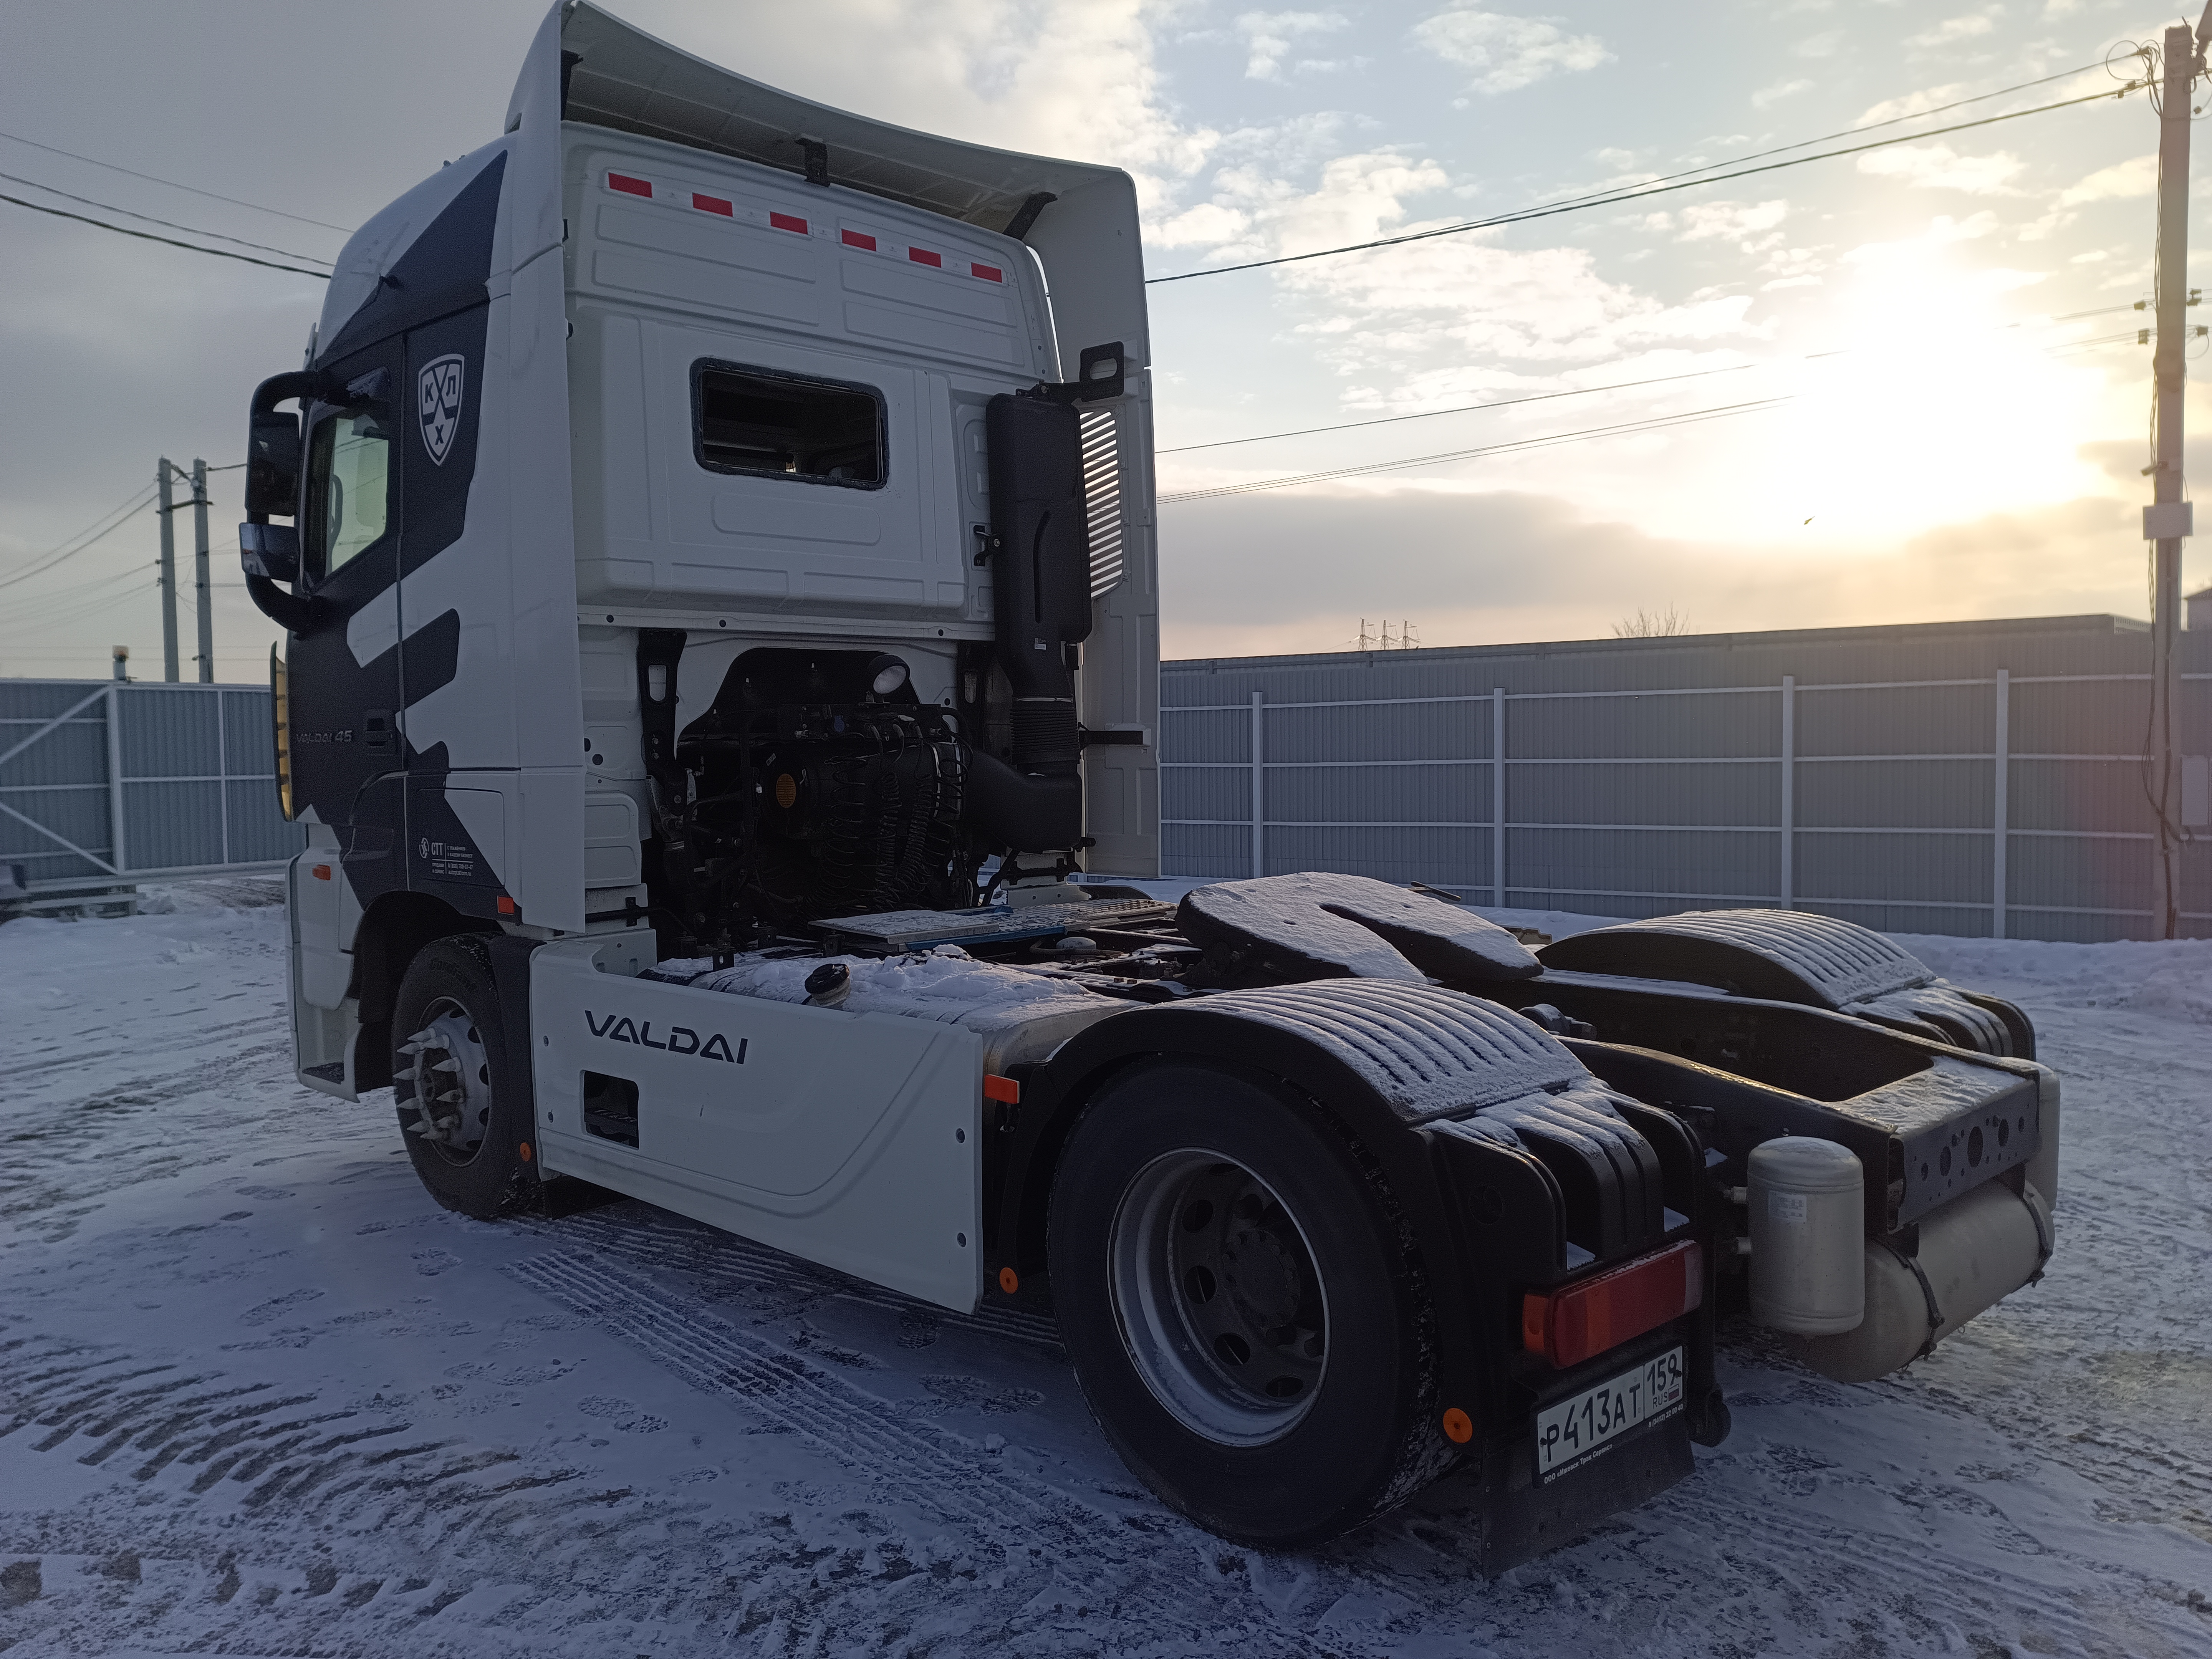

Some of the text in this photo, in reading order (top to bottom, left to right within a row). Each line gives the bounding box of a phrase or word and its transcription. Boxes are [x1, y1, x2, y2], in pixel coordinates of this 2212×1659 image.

[335, 730, 353, 742] 45
[584, 1010, 748, 1065] VALDAI
[1647, 1353, 1677, 1396] 159
[1652, 1392, 1668, 1409] RUS
[1544, 1473, 1556, 1484] ООО
[1580, 1454, 1592, 1465] Трак
